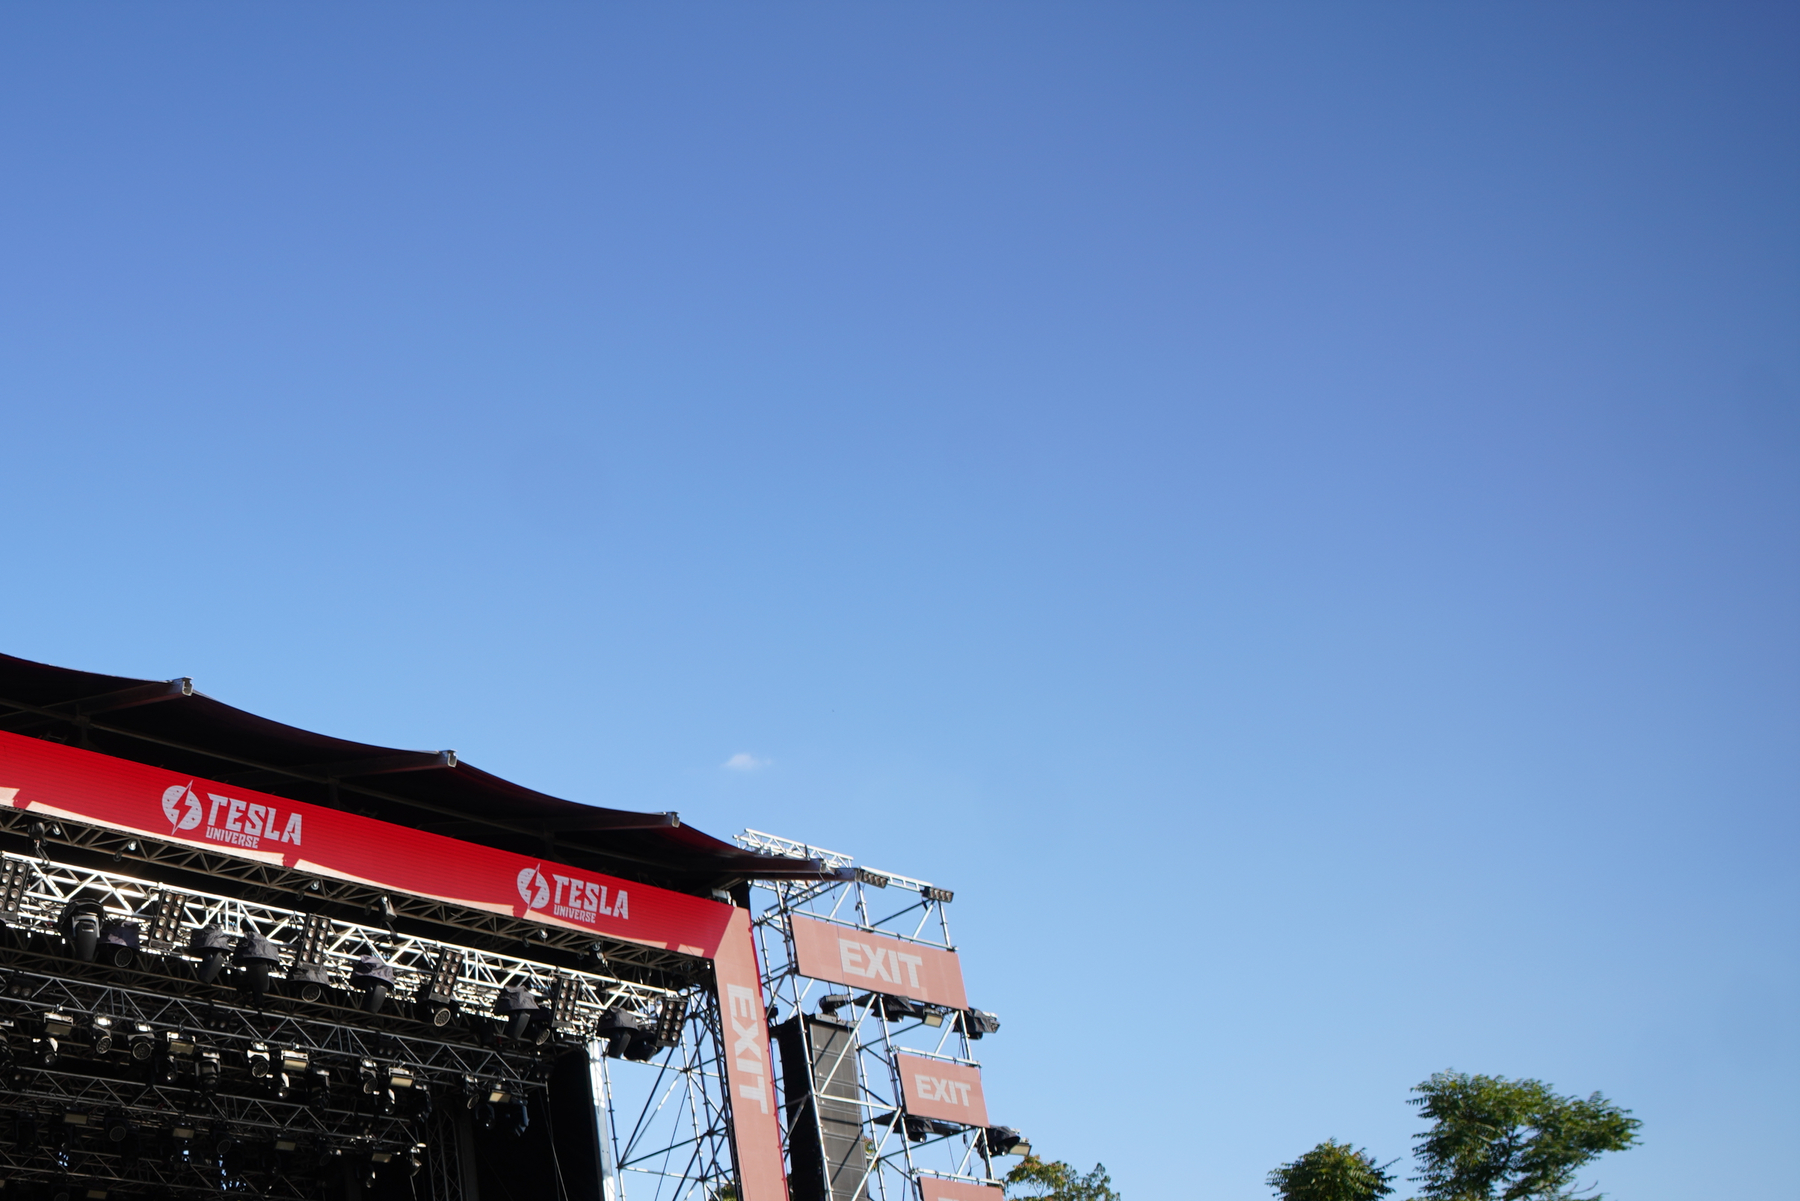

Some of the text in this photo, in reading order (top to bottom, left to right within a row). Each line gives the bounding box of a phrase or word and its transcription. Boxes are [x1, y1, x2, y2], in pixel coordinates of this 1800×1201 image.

[205, 825, 260, 849] UNIVERSE
[206, 792, 303, 846] TESLA
[552, 873, 629, 920] TESLA
[553, 903, 597, 924] UNIVERSE
[838, 938, 923, 989] EXIT
[726, 983, 768, 1115] EXIT
[914, 1074, 971, 1107] EXIT
